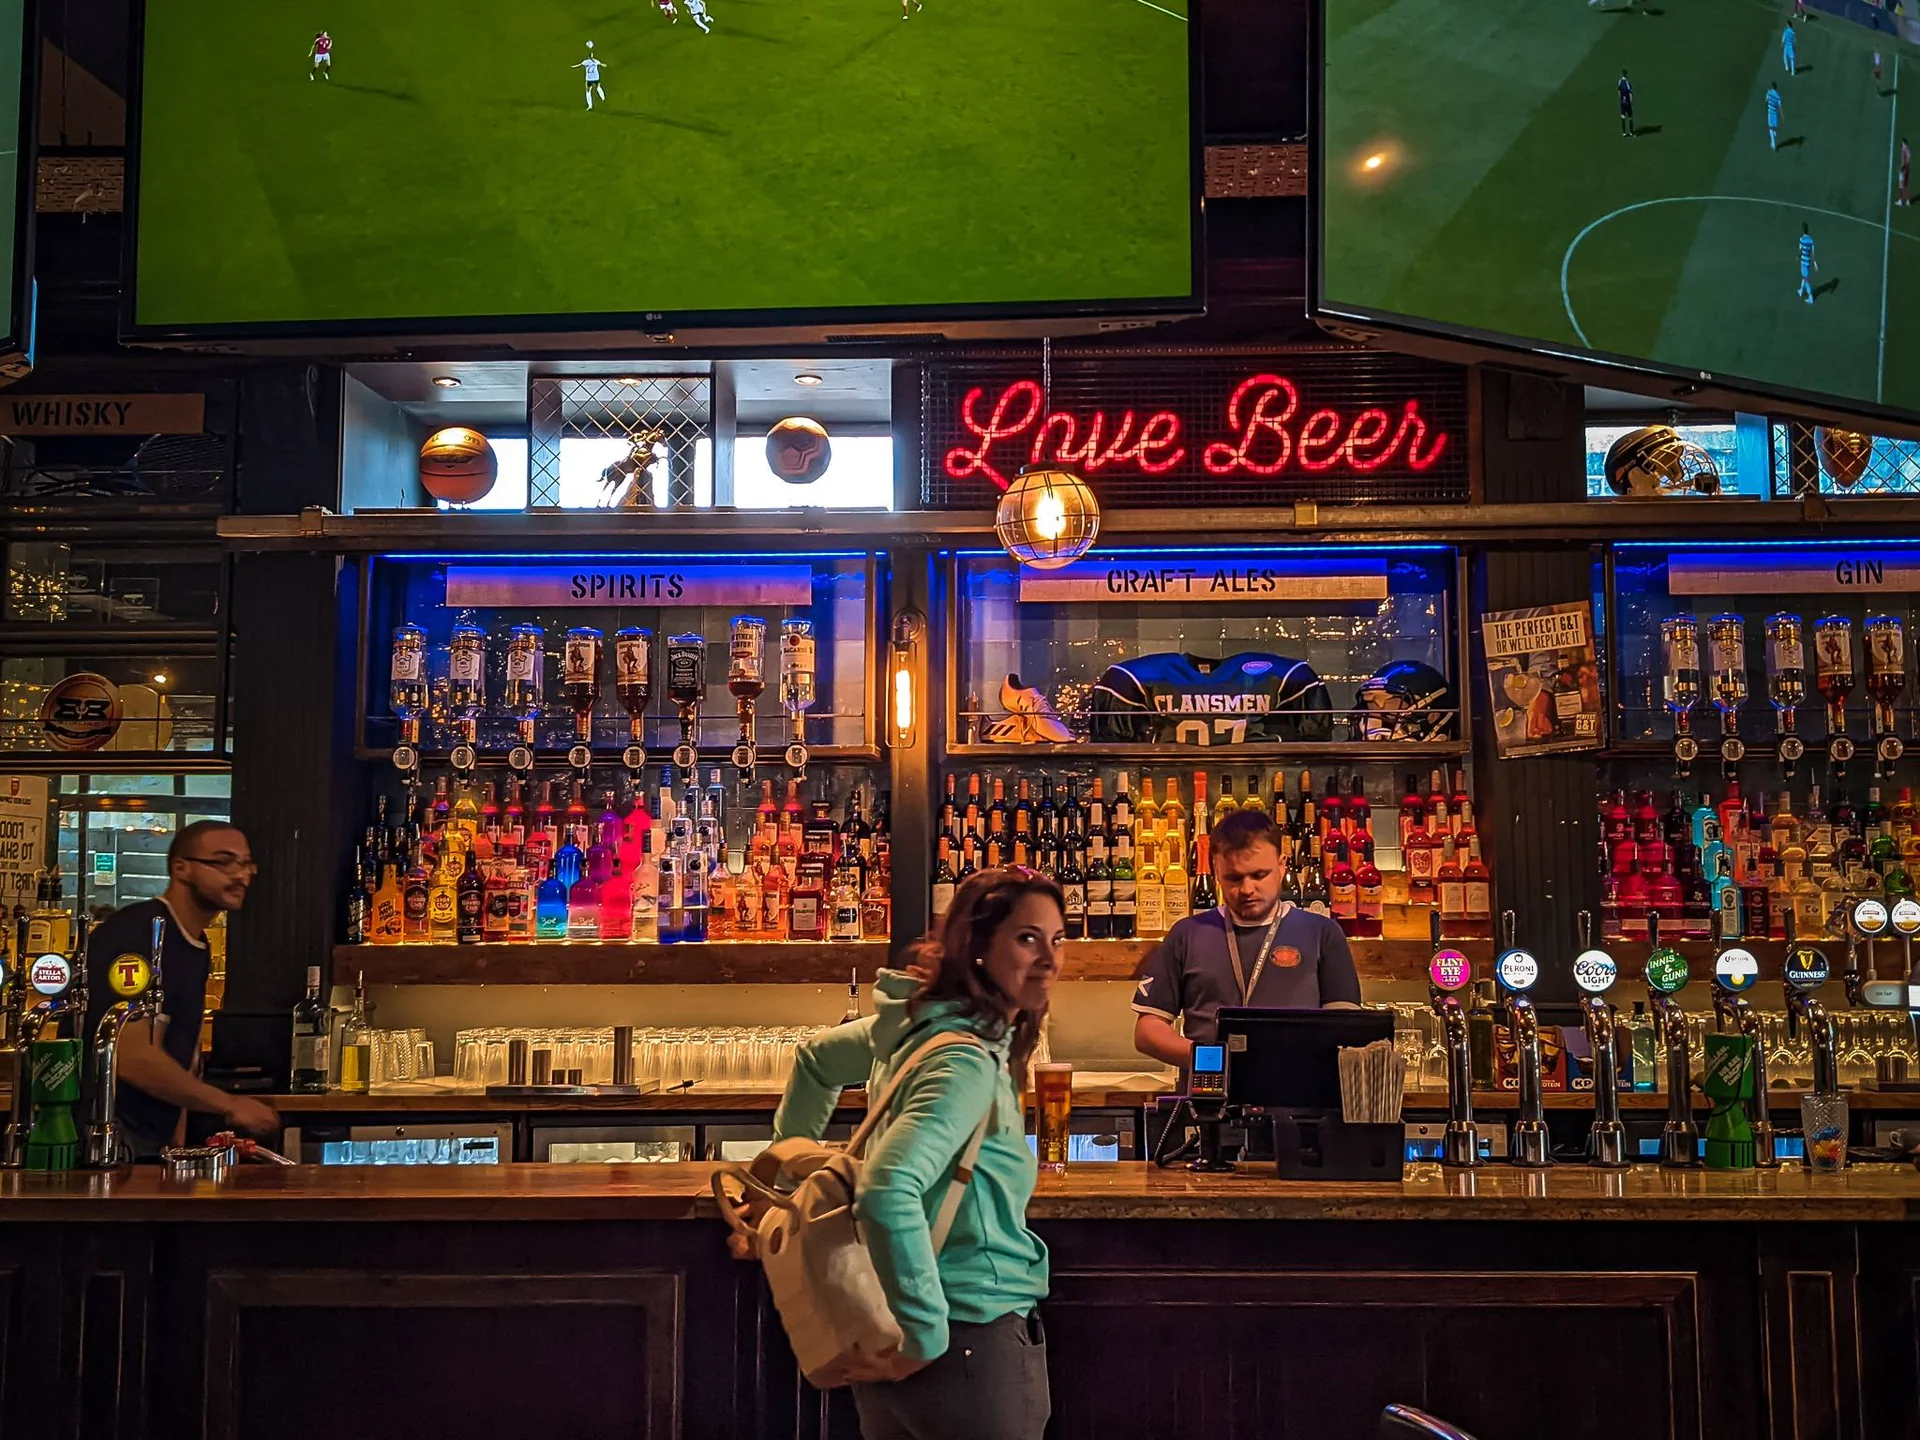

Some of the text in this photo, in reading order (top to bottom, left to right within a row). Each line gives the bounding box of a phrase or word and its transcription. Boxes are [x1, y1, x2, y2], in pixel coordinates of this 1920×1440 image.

[11, 401, 132, 426] WHISKY
[945, 373, 1449, 491] Love Beer
[1836, 559, 1883, 585] GIN
[571, 573, 685, 599] SPIRITS
[1107, 568, 1276, 593] CRAFT ALES
[1494, 613, 1580, 639] THE PERFECT G&T
[1496, 630, 1581, 653] OR WE'LL REPLACE IT
[1154, 694, 1271, 713] CLANSMEN
[1575, 720, 1596, 731] G&T
[1436, 957, 1464, 967] FLINT
[1504, 964, 1534, 972] PERONI
[1576, 960, 1617, 976] Coors
[1649, 954, 1676, 969] INNIS
[1664, 964, 1673, 974] &
[118, 963, 139, 987] T
[1441, 967, 1461, 976] EYE
[1661, 968, 1688, 983] GUNN
[1789, 970, 1826, 979] GUINNESS
[1583, 976, 1610, 984] LIGHT
[1574, 1079, 1592, 1087] KP
